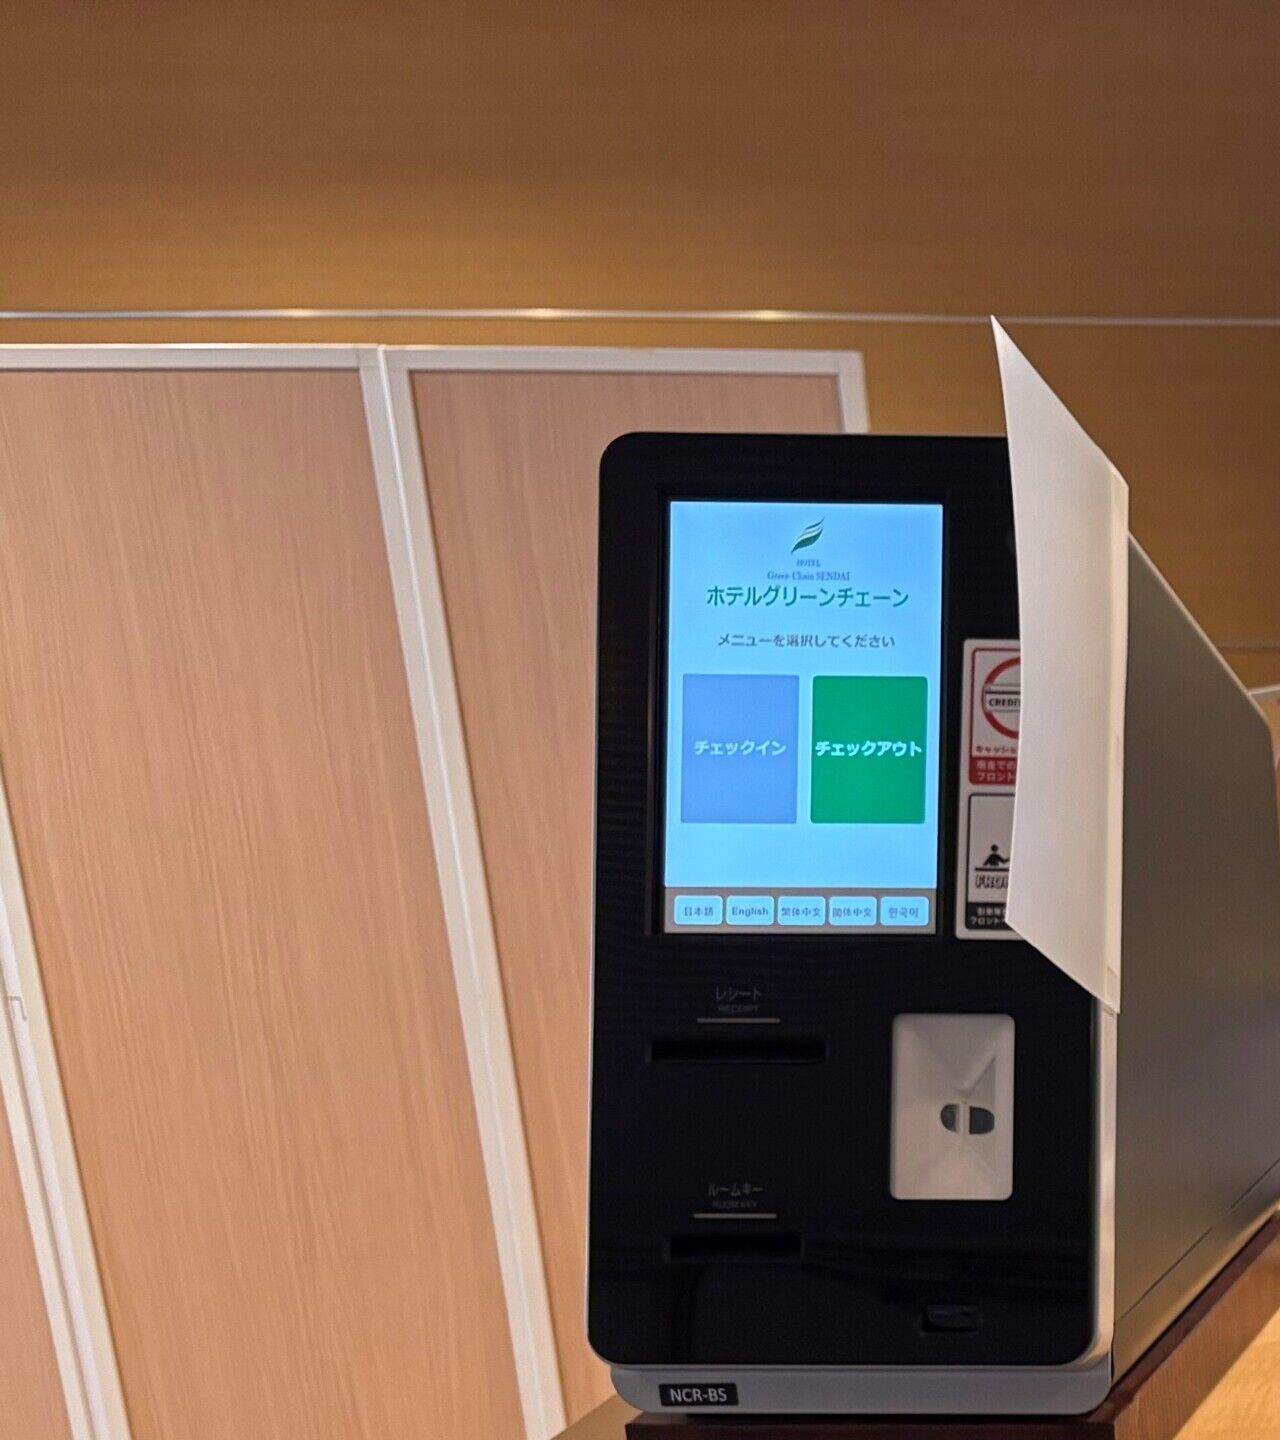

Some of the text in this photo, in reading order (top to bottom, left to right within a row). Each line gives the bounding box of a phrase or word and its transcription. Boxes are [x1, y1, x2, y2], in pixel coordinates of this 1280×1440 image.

[767, 571, 850, 580] Green Chain SENDAI
[707, 585, 909, 607] ホテルグリーンチェーン
[718, 633, 896, 648] メニューを選択してください
[694, 740, 787, 757] チェックイン
[815, 740, 922, 757] チェックアウト
[684, 907, 714, 918] 日本語
[732, 907, 768, 919] English
[716, 985, 762, 1000] レシート
[708, 1183, 764, 1197] ルームキー
[670, 1387, 728, 1403] NCR-BS
